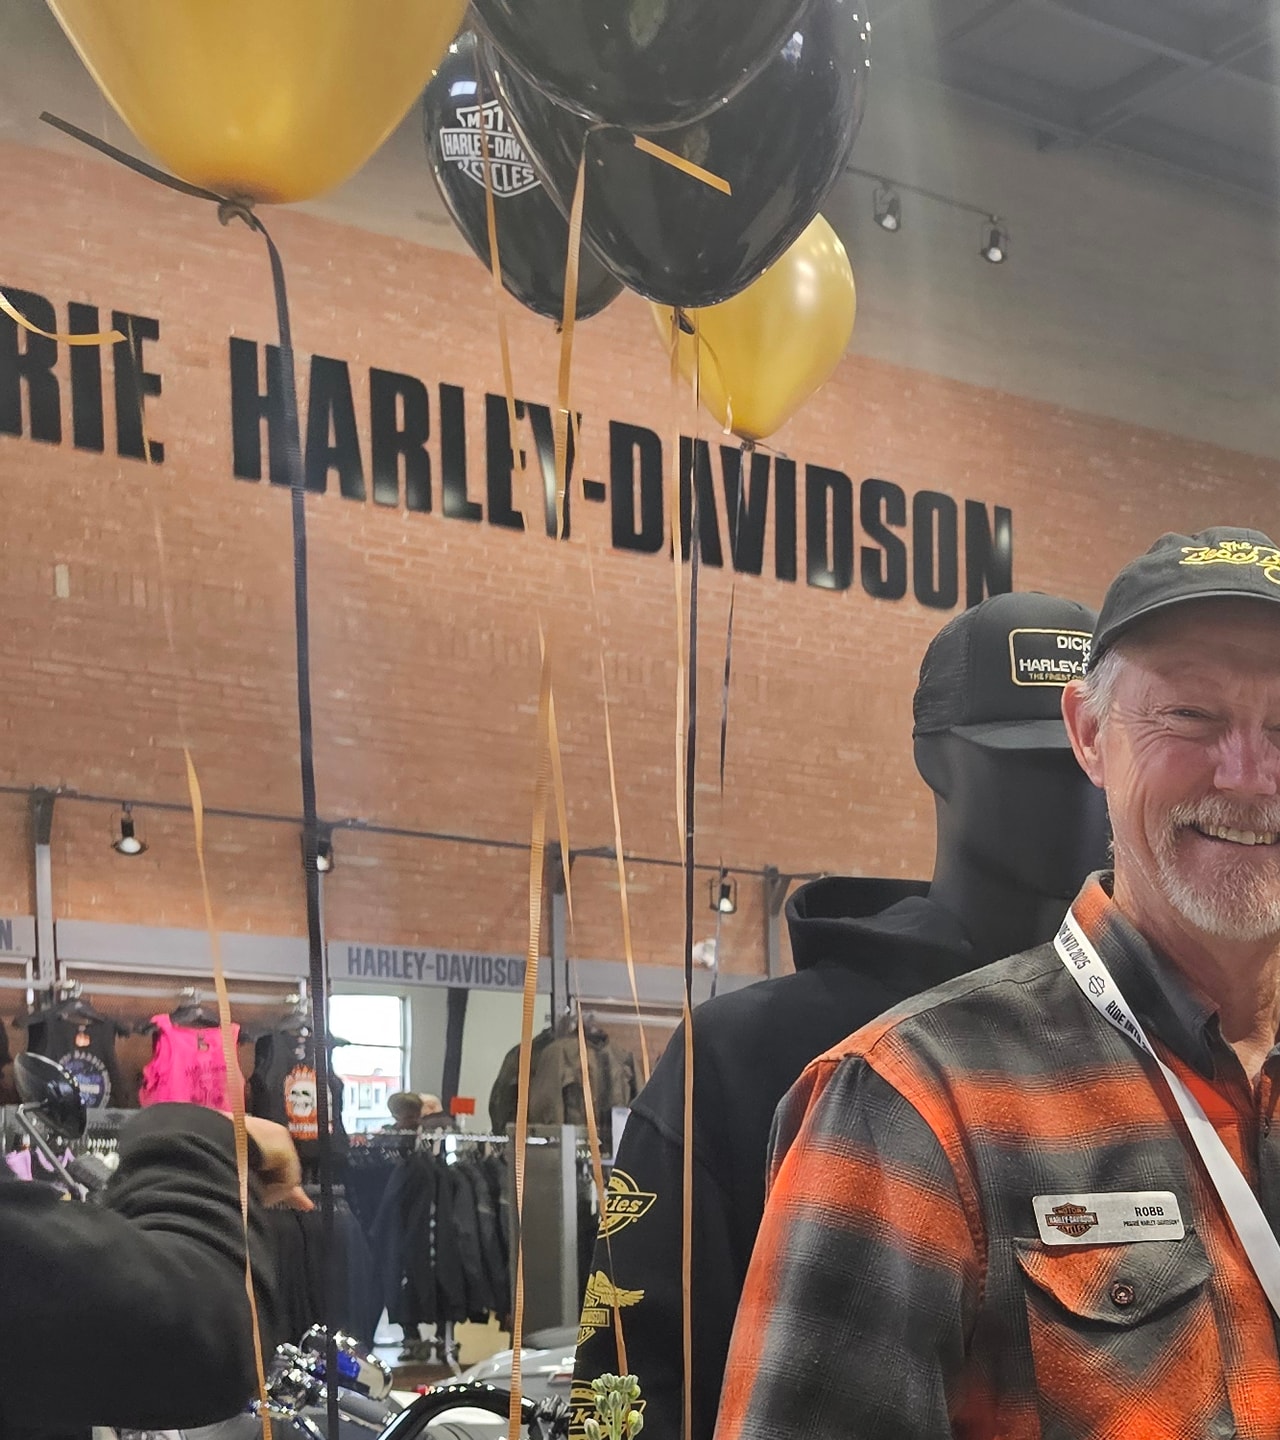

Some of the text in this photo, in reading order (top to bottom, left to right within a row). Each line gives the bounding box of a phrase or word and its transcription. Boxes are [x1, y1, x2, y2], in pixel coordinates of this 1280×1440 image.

[229, 336, 1013, 612] HARLEY-DAVIDSON
[1057, 636, 1092, 651] DICK
[1069, 947, 1091, 970] 2025
[1105, 1000, 1126, 1024] RIDE
[1135, 1207, 1164, 1217] ROBB
